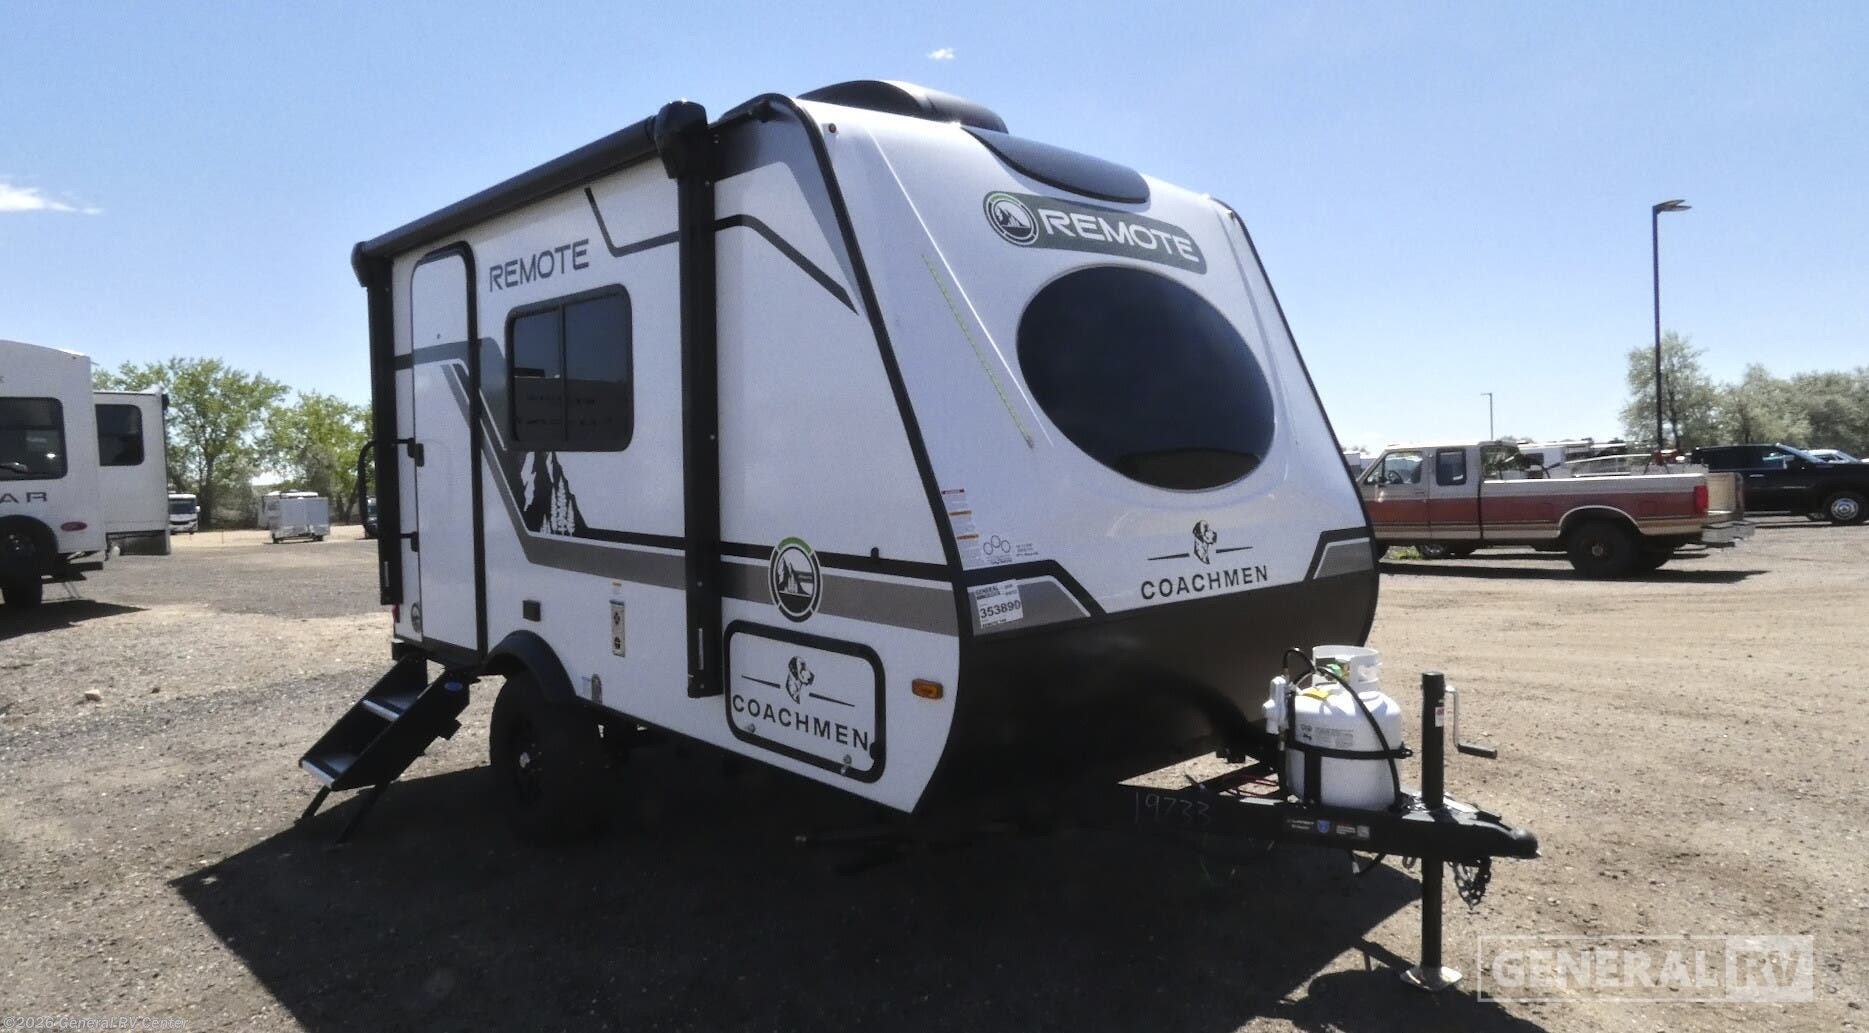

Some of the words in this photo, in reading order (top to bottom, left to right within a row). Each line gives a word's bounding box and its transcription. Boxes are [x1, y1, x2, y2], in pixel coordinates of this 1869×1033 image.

[1037, 208, 1200, 263] REMOTE
[489, 239, 589, 292] REMOTE
[980, 599, 1021, 618] 353890
[1140, 564, 1268, 600] COACHMEN
[732, 694, 868, 751] COACHMEN
